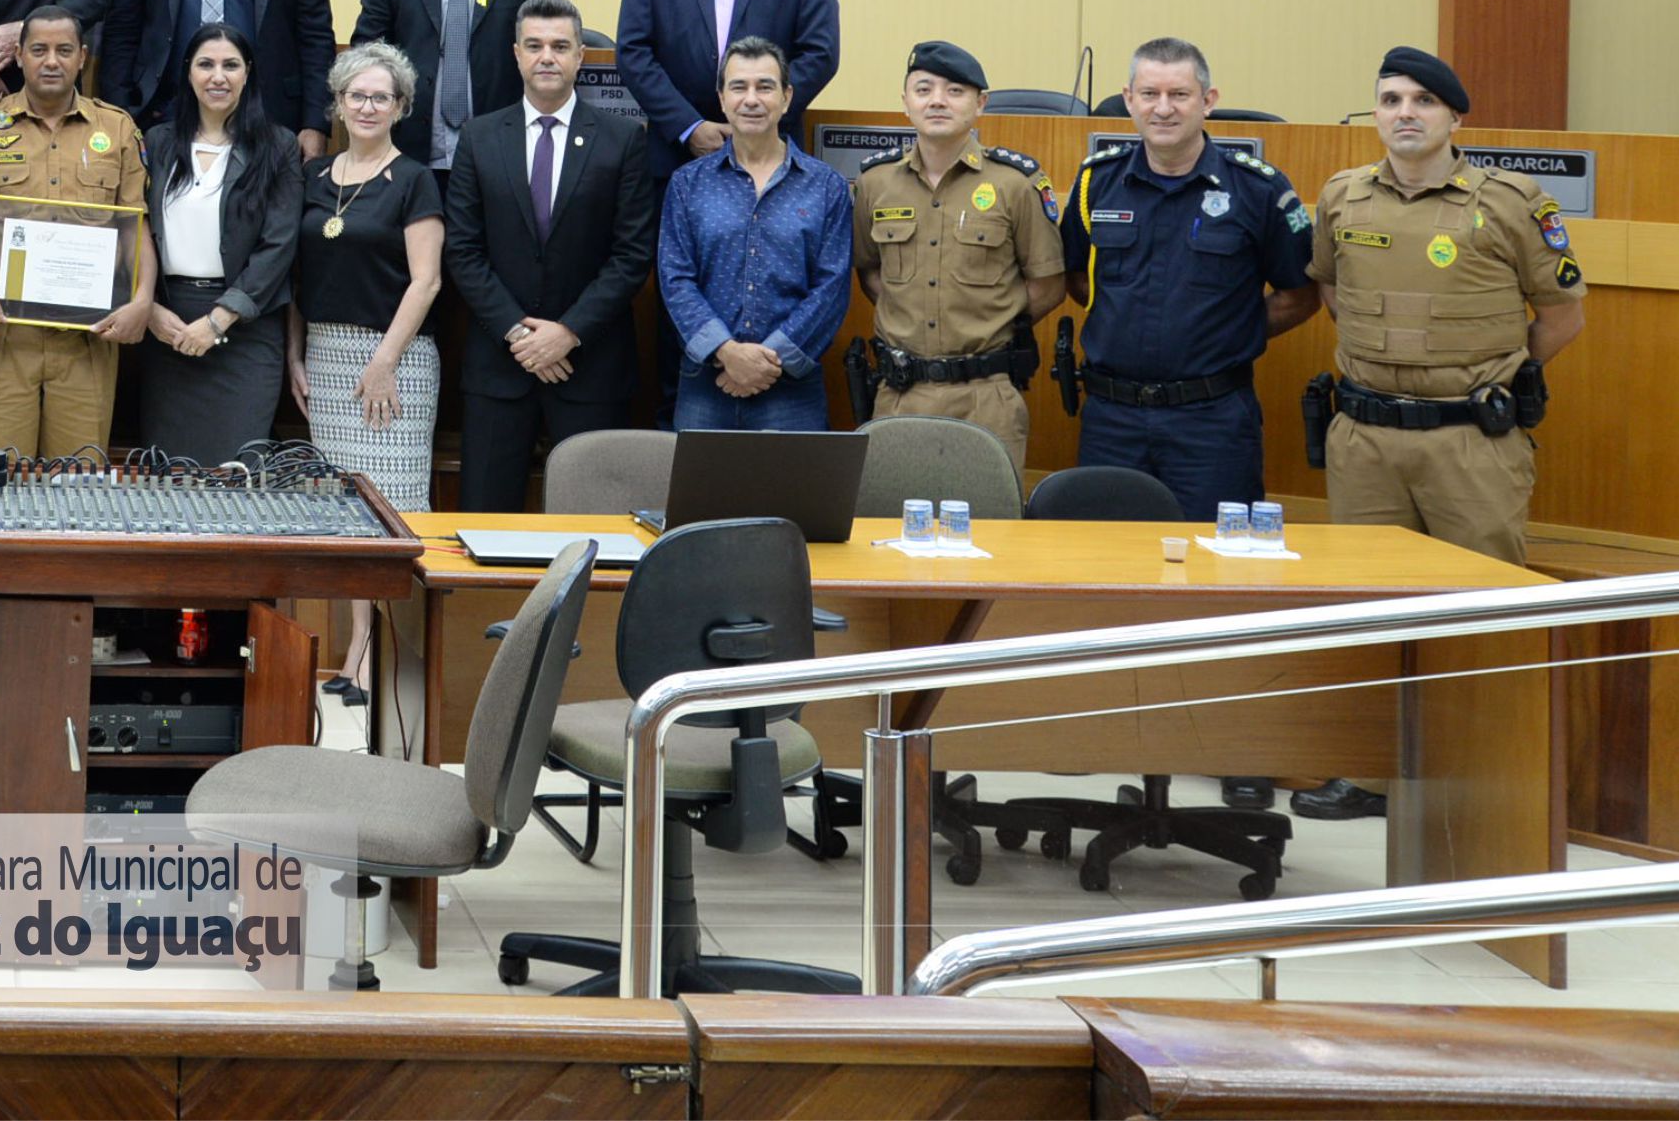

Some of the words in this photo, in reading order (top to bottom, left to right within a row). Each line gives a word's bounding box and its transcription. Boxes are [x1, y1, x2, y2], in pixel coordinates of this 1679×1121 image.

[601, 89, 624, 99] PSD
[827, 134, 898, 146] JEFERSON
[1499, 157, 1567, 172] GARCIA
